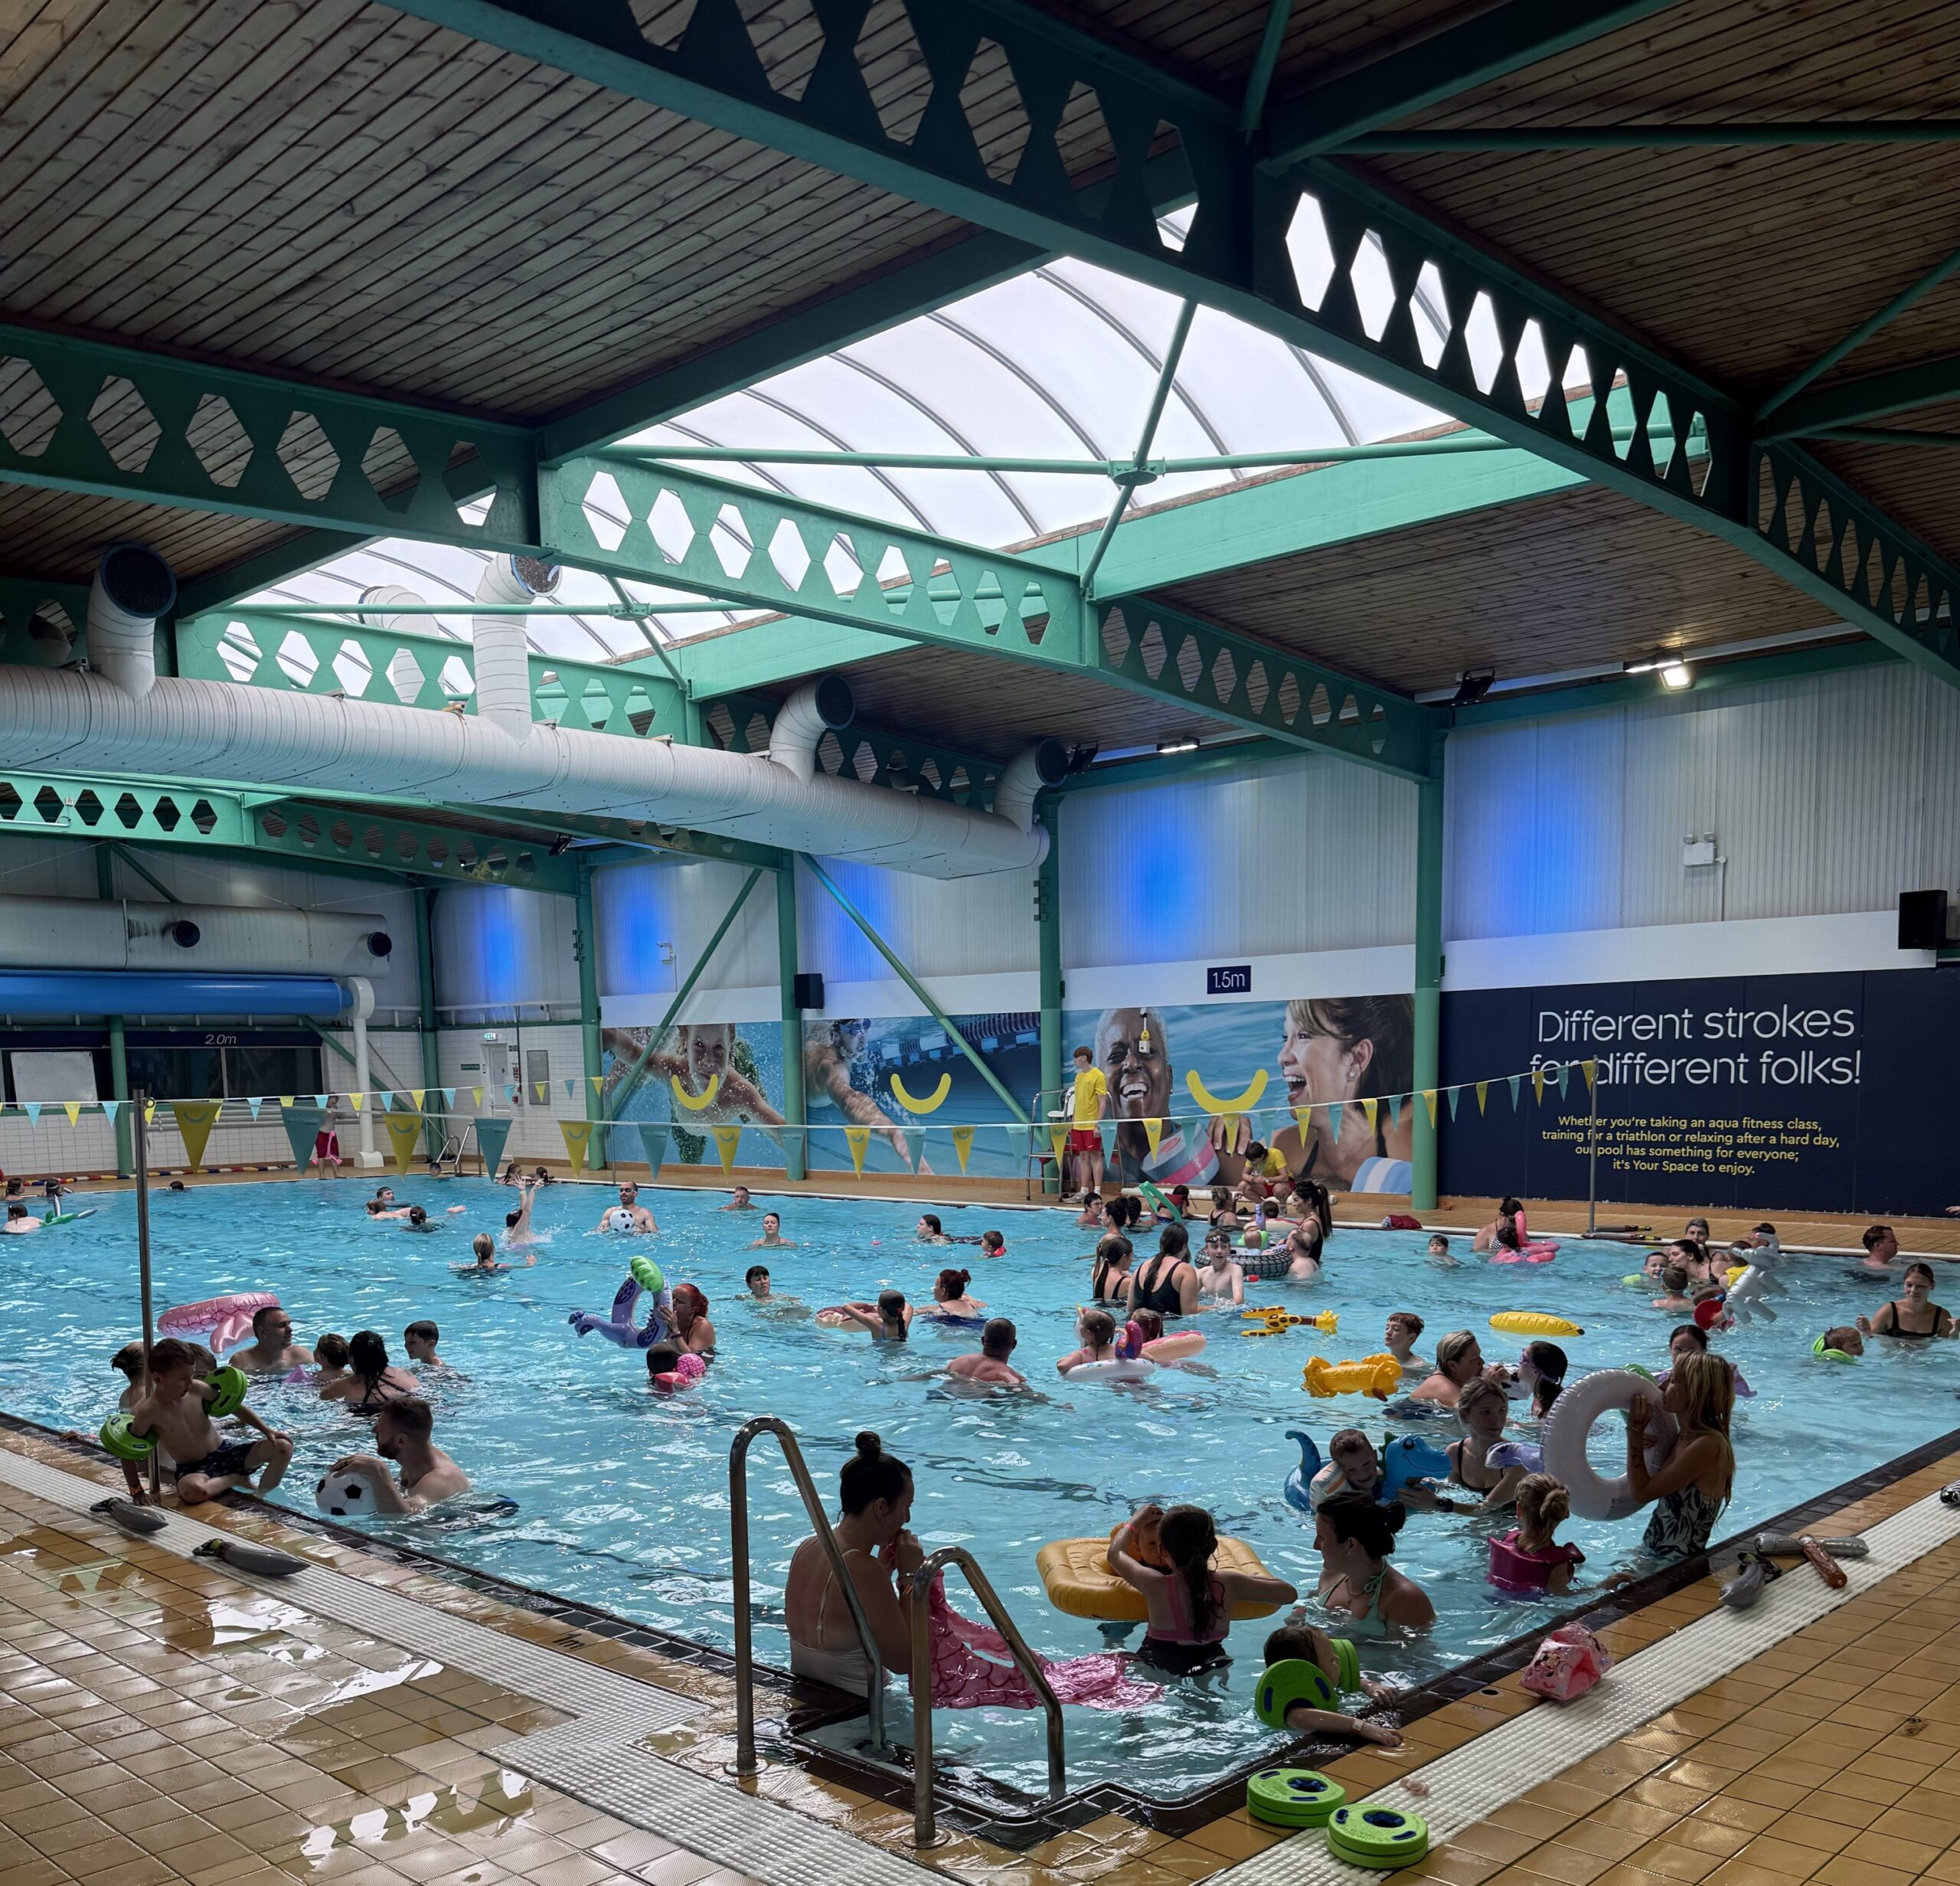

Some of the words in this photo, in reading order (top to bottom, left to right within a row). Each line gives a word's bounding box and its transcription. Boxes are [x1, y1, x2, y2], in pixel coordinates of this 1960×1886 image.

[1213, 971, 1245, 988] 1.5m
[1538, 1008, 1694, 1042] Different
[1703, 1004, 1854, 1039] strokes
[204, 1034, 237, 1044] 2.0m
[1592, 1052, 1749, 1085] different
[1759, 1050, 1861, 1085] folks!
[1610, 1116, 1647, 1129] you're
[1650, 1116, 1687, 1129] taking
[1690, 1119, 1705, 1128] an
[1708, 1120, 1739, 1130] aqua
[1742, 1117, 1783, 1129] fitness
[1787, 1118, 1821, 1133] class,
[1542, 1129, 1584, 1142] training
[1606, 1133, 1612, 1141] a
[1615, 1130, 1665, 1142] triathlon
[1668, 1133, 1682, 1142] or
[1685, 1132, 1733, 1146] relaxing
[1736, 1133, 1766, 1144] after
[1769, 1136, 1776, 1144] a
[1780, 1133, 1809, 1145] hard
[1813, 1133, 1840, 1148] day,
[1597, 1144, 1623, 1157] pool
[1626, 1145, 1646, 1155] has
[1648, 1146, 1713, 1159] something
[1716, 1146, 1733, 1158] for
[1736, 1149, 1799, 1162] everyone;
[1612, 1159, 1630, 1170] it's
[1632, 1159, 1659, 1171] Your
[1661, 1161, 1699, 1173] Space
[1702, 1162, 1715, 1172] to
[1718, 1162, 1756, 1176] enjoy.
[552, 1633, 585, 1649] 1m
